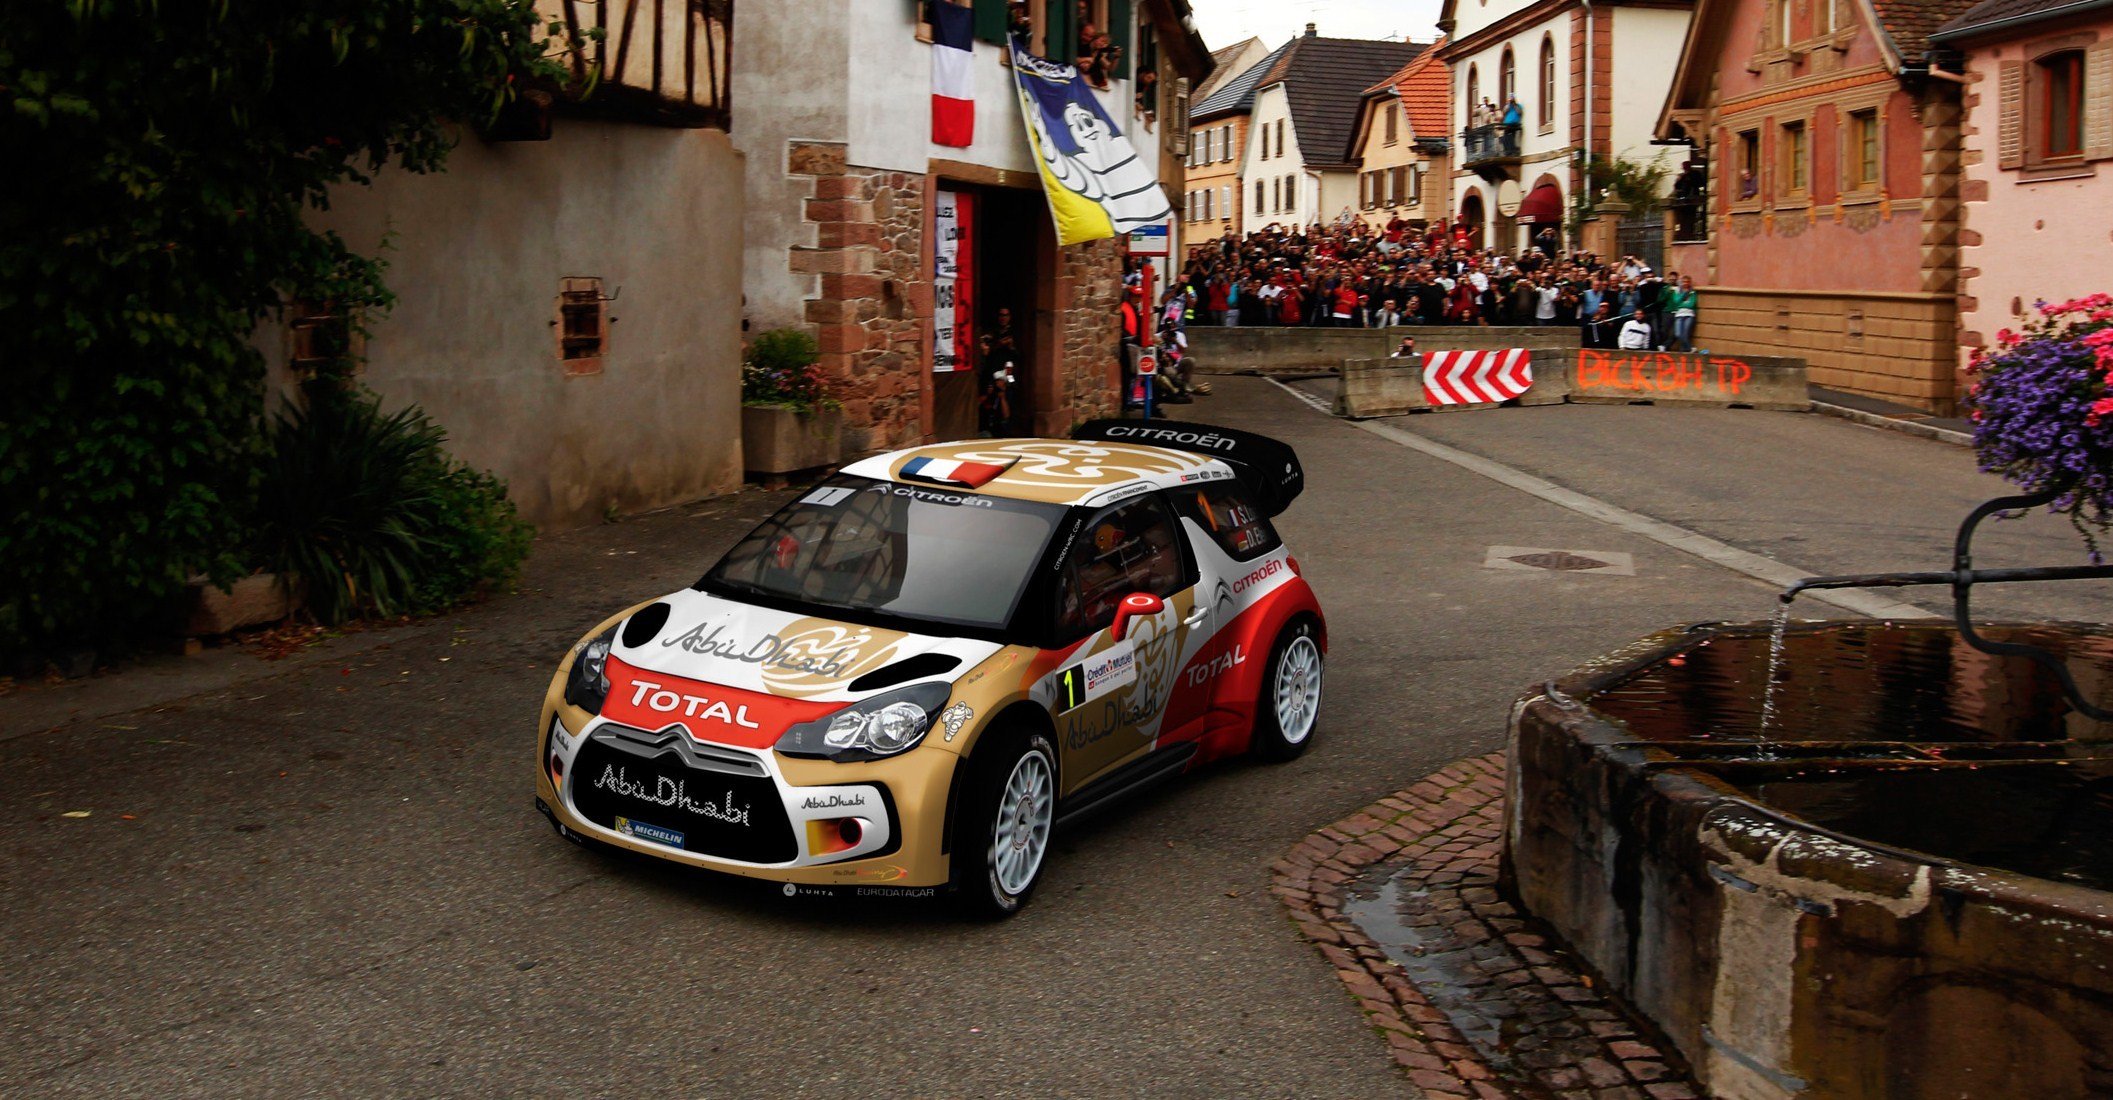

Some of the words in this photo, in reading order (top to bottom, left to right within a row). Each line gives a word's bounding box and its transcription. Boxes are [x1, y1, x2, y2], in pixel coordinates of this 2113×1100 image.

[1709, 358, 1752, 394] TP
[1106, 426, 1236, 451] CITROËN
[893, 487, 993, 508] CITROËN
[1233, 559, 1283, 594] CITROËN
[1087, 664, 1107, 681] Crédit
[1112, 652, 1133, 668] Mutuel
[1186, 644, 1246, 688] TOTAL
[1063, 669, 1075, 709] 1
[630, 679, 760, 729] TOTAL
[634, 825, 683, 844] MICHELIN
[799, 888, 833, 897] LUHTA
[857, 887, 935, 897] EURODATACAR
